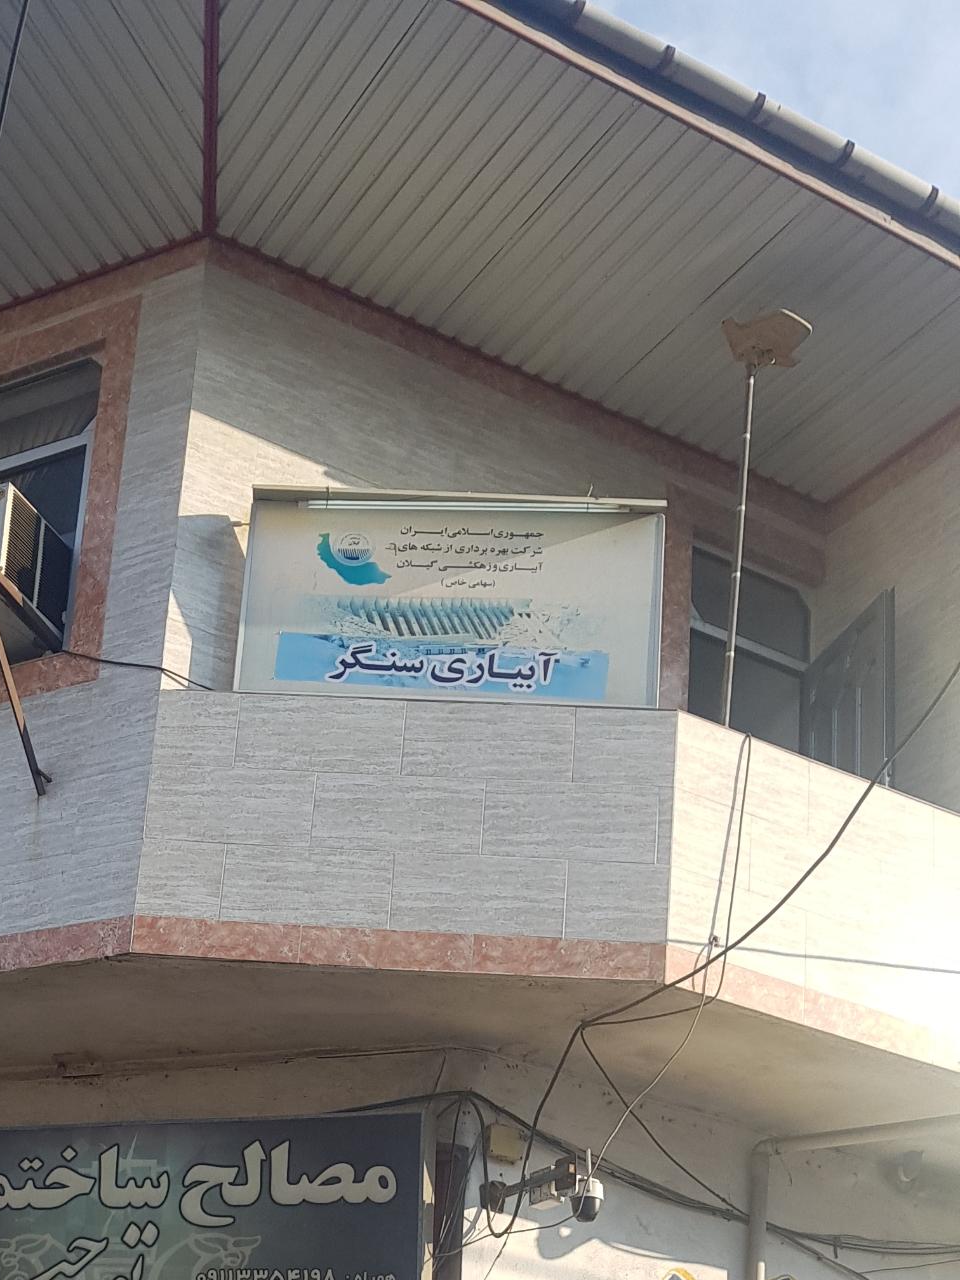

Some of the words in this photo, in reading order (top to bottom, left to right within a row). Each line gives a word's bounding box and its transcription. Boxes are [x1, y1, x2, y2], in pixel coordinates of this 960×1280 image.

[400, 525, 448, 537] ایران
[447, 527, 494, 539] اسلامی
[493, 530, 544, 539] جمهوری
[420, 542, 442, 554] شبکه
[444, 543, 453, 554] از
[454, 543, 488, 556] برداری
[490, 546, 509, 557] بهره
[511, 544, 543, 557] شرکت
[396, 559, 438, 570] گیلان
[498, 561, 544, 573] آبیاری
[327, 644, 424, 680] سنگر
[430, 651, 558, 689] آبیاری
[179, 1140, 399, 1228] مصالح
